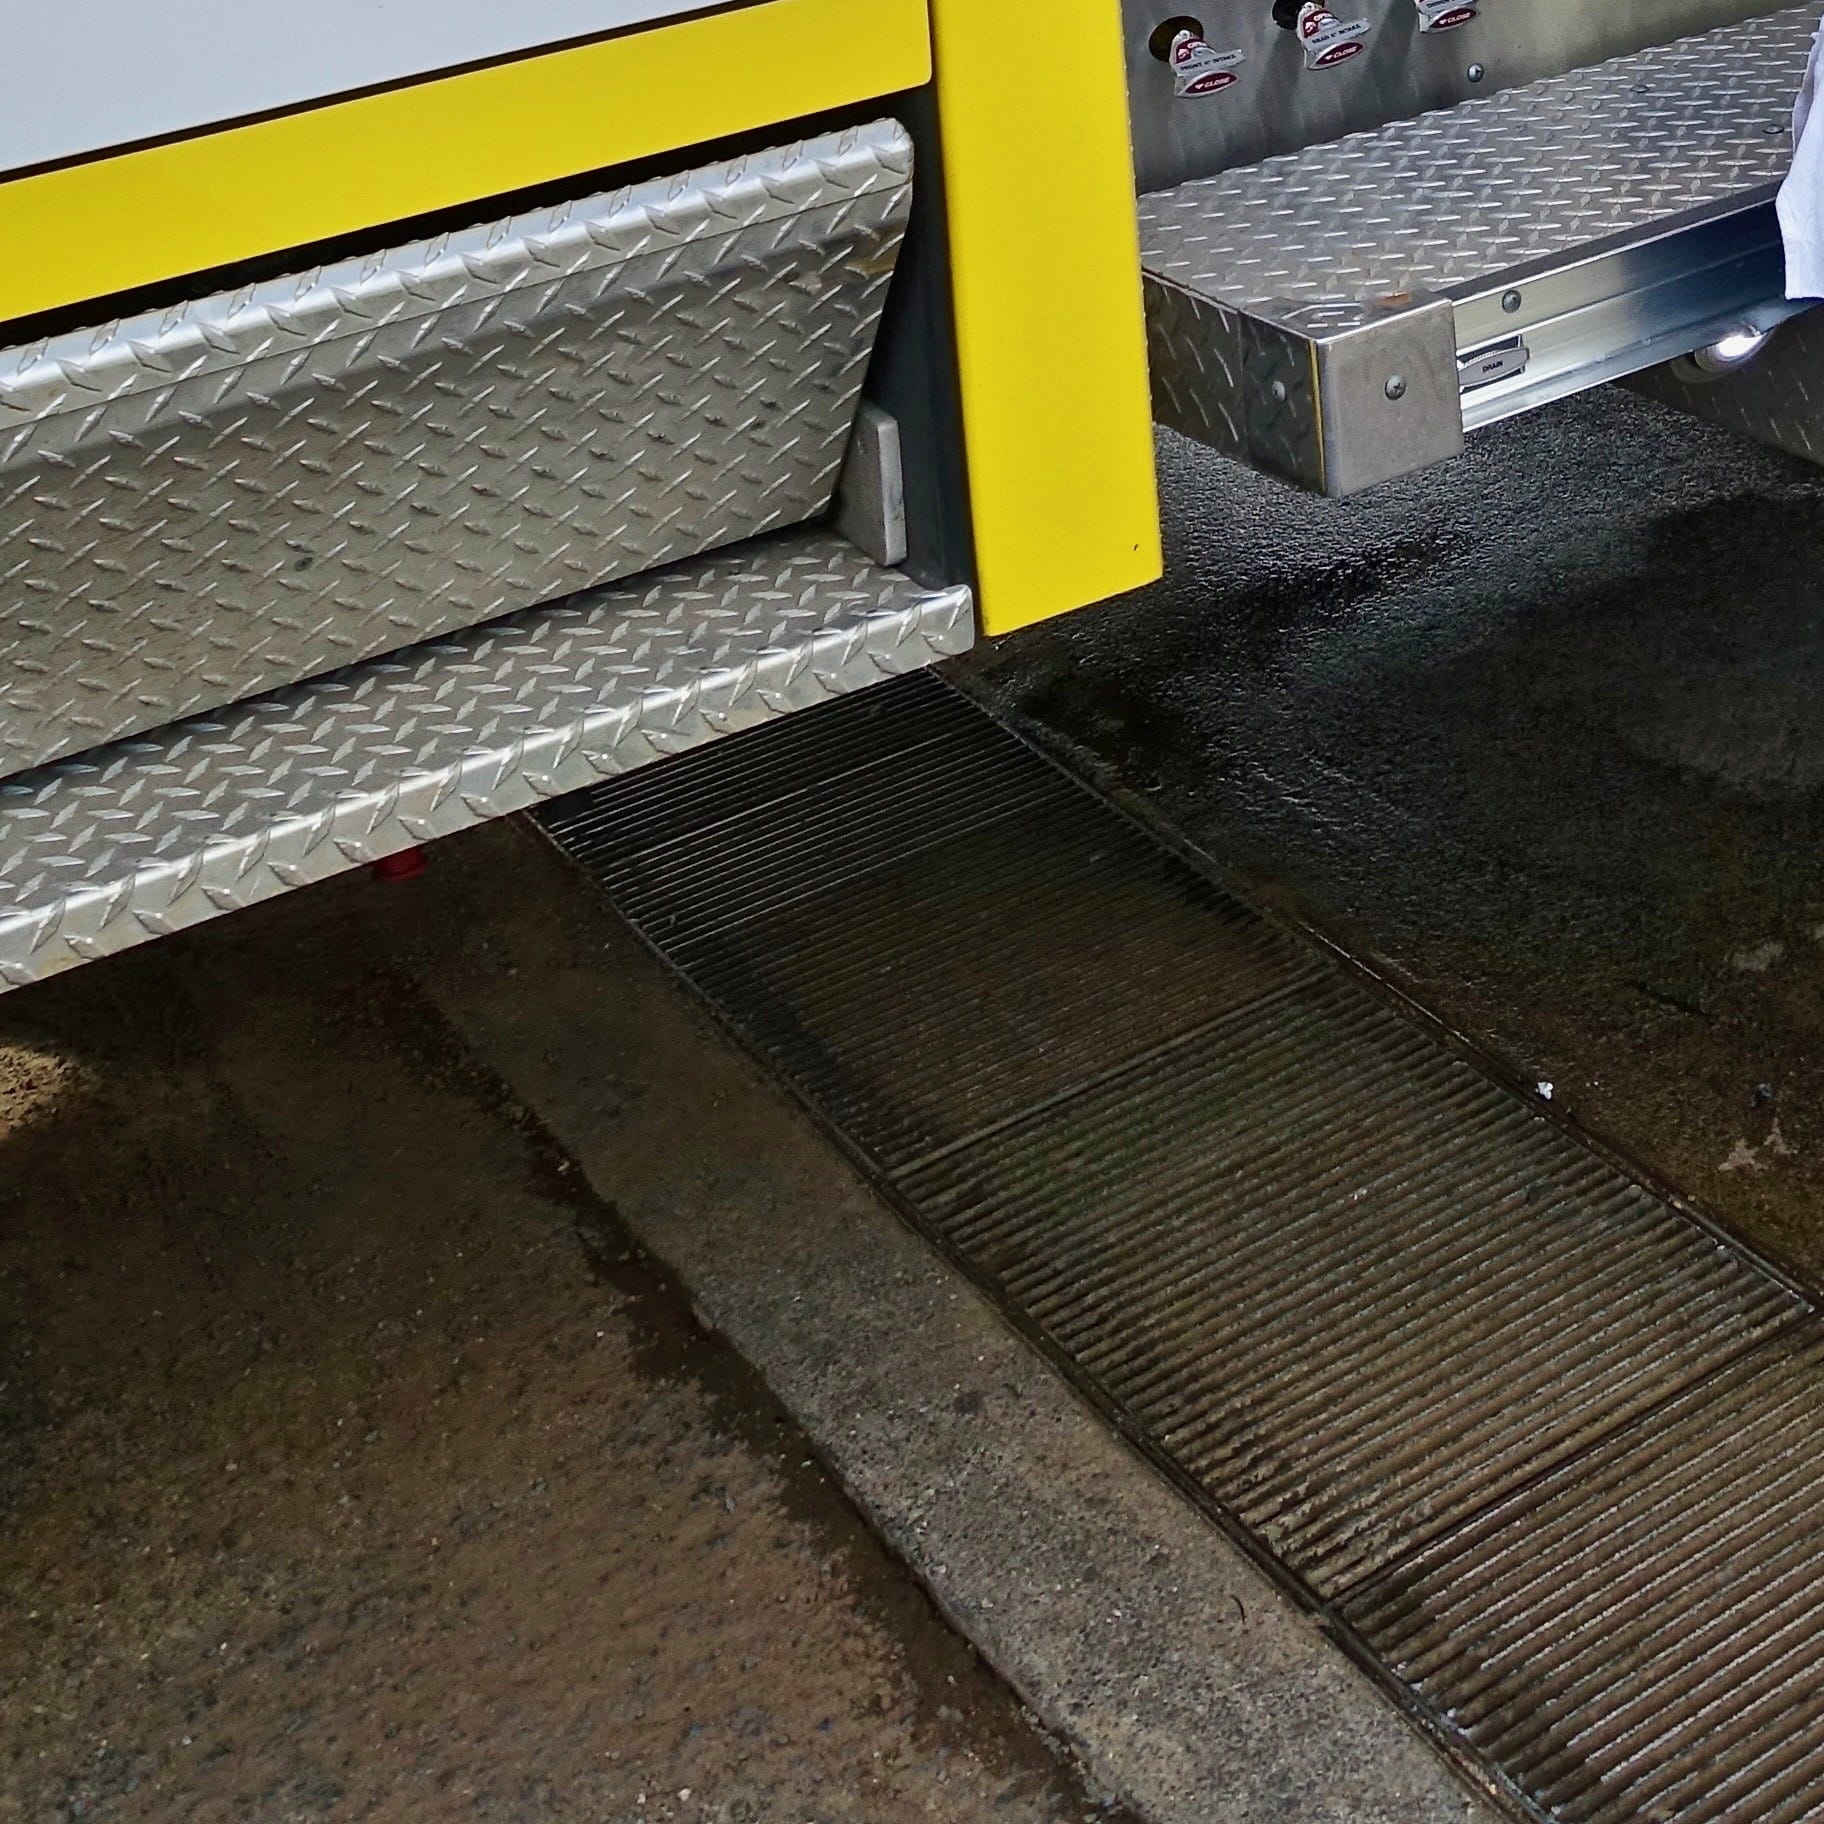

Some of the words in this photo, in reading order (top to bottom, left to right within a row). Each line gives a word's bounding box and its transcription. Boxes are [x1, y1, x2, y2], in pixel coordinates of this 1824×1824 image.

[1447, 11, 1471, 23] CLOSE
[1333, 45, 1358, 58] CLOSE
[1204, 76, 1230, 88] CLOSE
[1482, 360, 1503, 373] DRAIN
